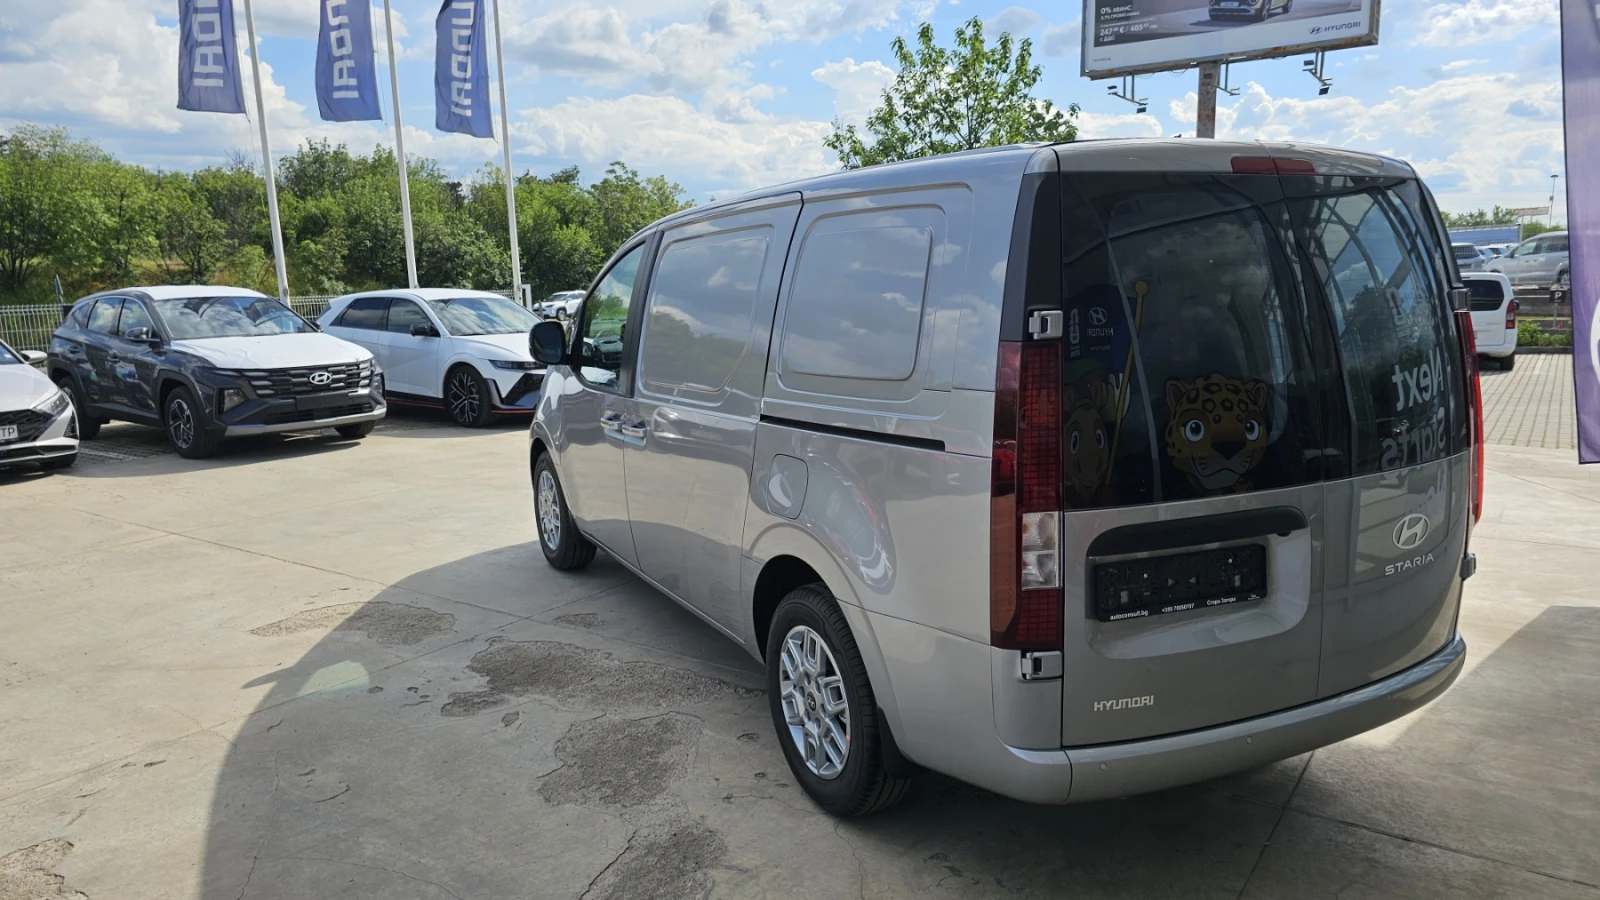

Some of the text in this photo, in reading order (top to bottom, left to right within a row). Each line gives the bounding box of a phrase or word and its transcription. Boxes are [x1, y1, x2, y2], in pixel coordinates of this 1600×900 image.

[1324, 21, 1361, 32] HYUNDAI
[1555, 291, 1562, 299] P
[1385, 553, 1434, 576] STARIA
[1110, 610, 1149, 621] autoconsult.bg
[1093, 695, 1154, 712] HYUNDAI
